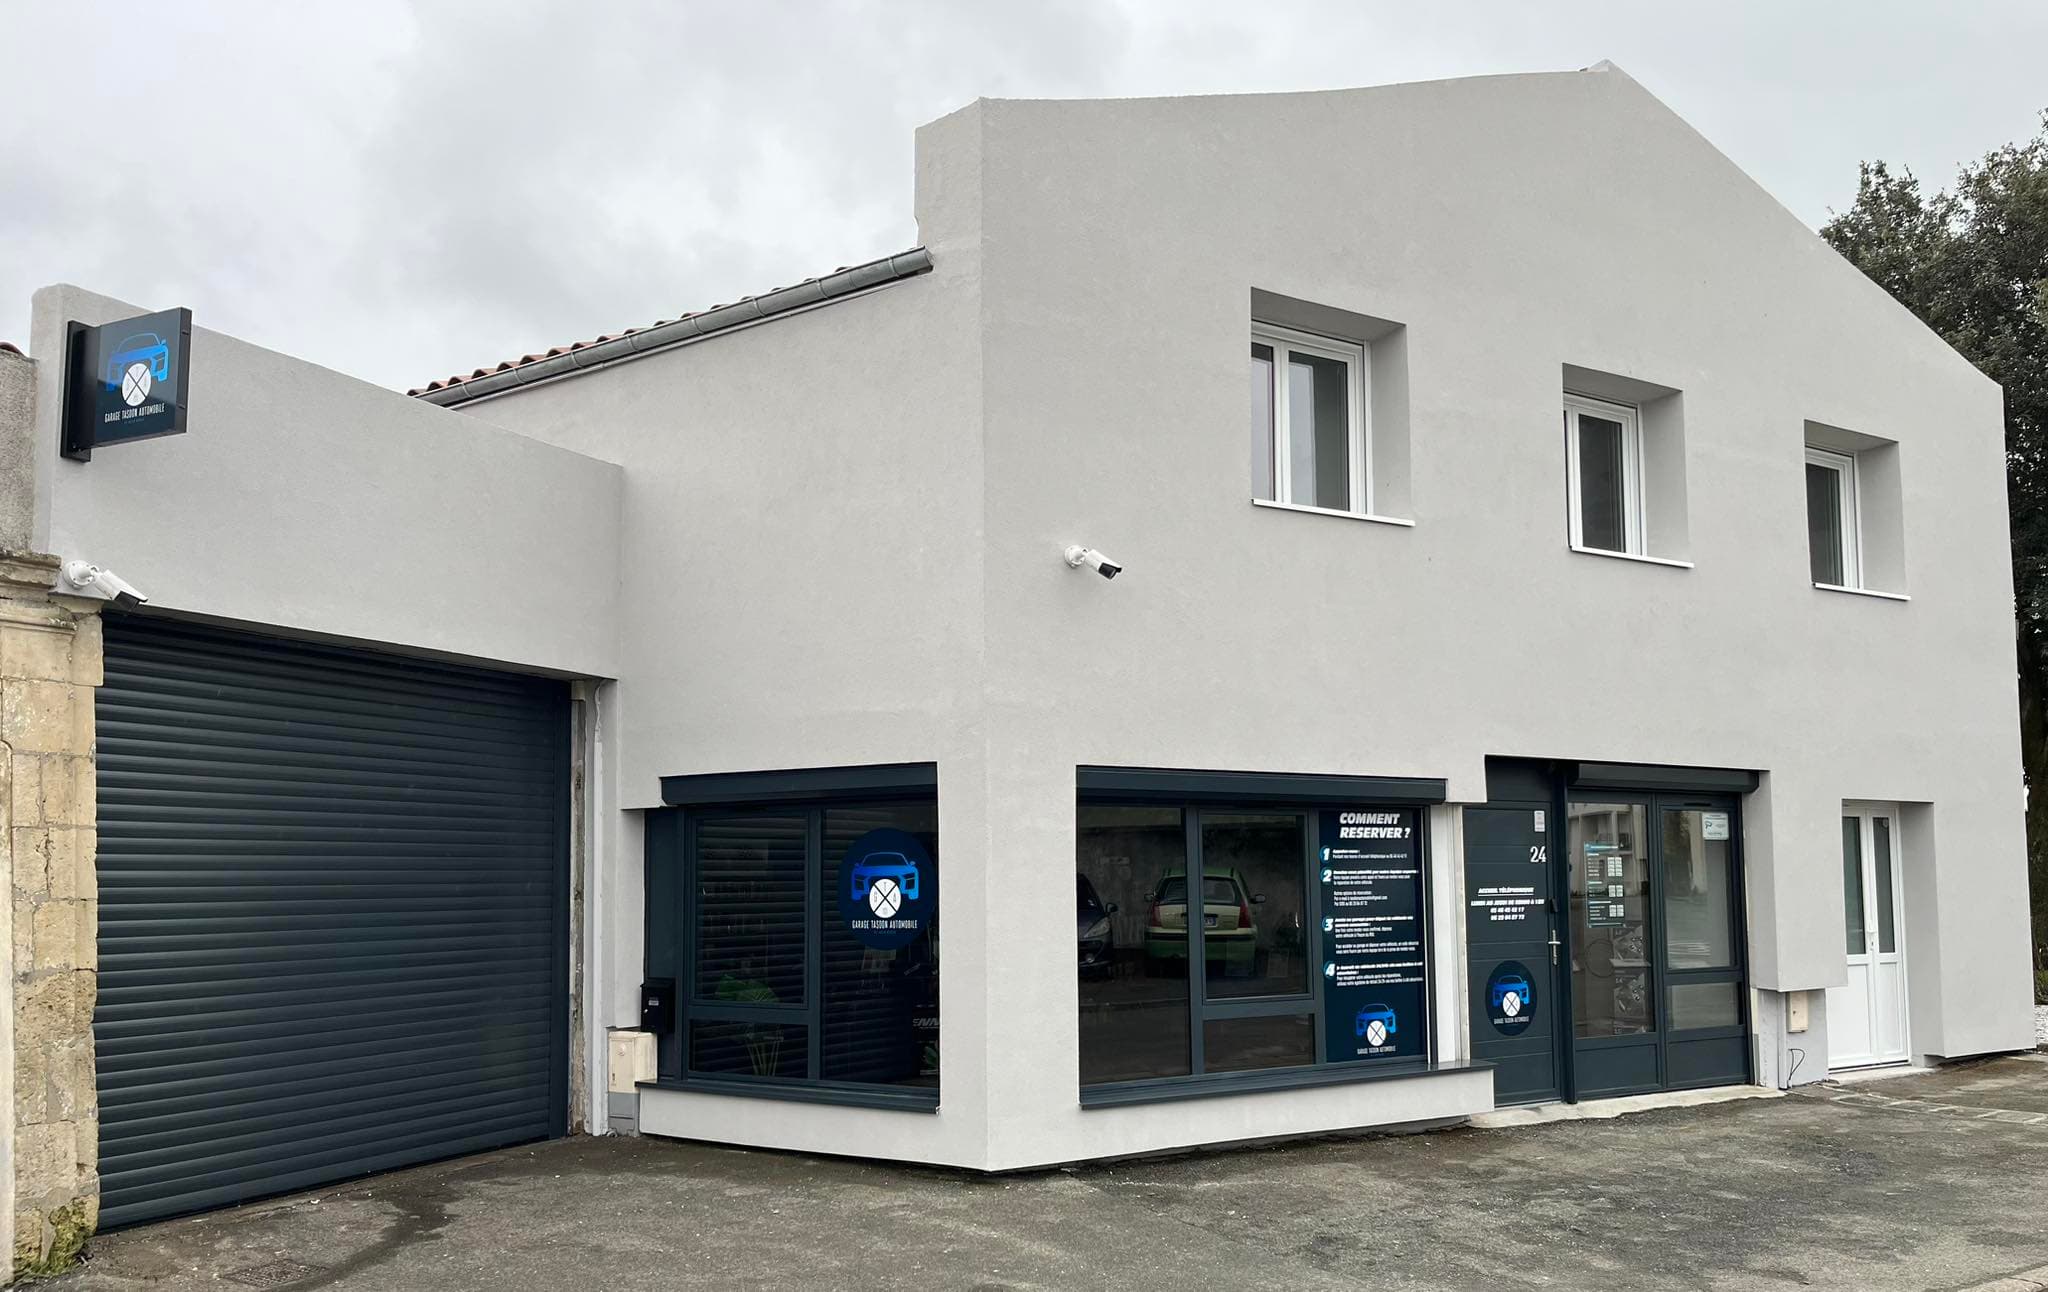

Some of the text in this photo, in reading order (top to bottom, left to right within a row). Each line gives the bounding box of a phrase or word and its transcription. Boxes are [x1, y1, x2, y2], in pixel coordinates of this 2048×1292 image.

[104, 411, 120, 423] GARAGE
[138, 402, 165, 416] AUTOMOBILE
[1339, 812, 1401, 825] COMMENT
[1339, 827, 1411, 839] RESERVER ?
[1323, 847, 1330, 861] 1
[1530, 846, 1547, 863] 24
[1322, 869, 1332, 882] 2
[851, 919, 869, 929] GARAGE
[889, 919, 918, 929] AUTOMOBILE
[1323, 918, 1334, 932] 3
[1325, 963, 1336, 977] 4
